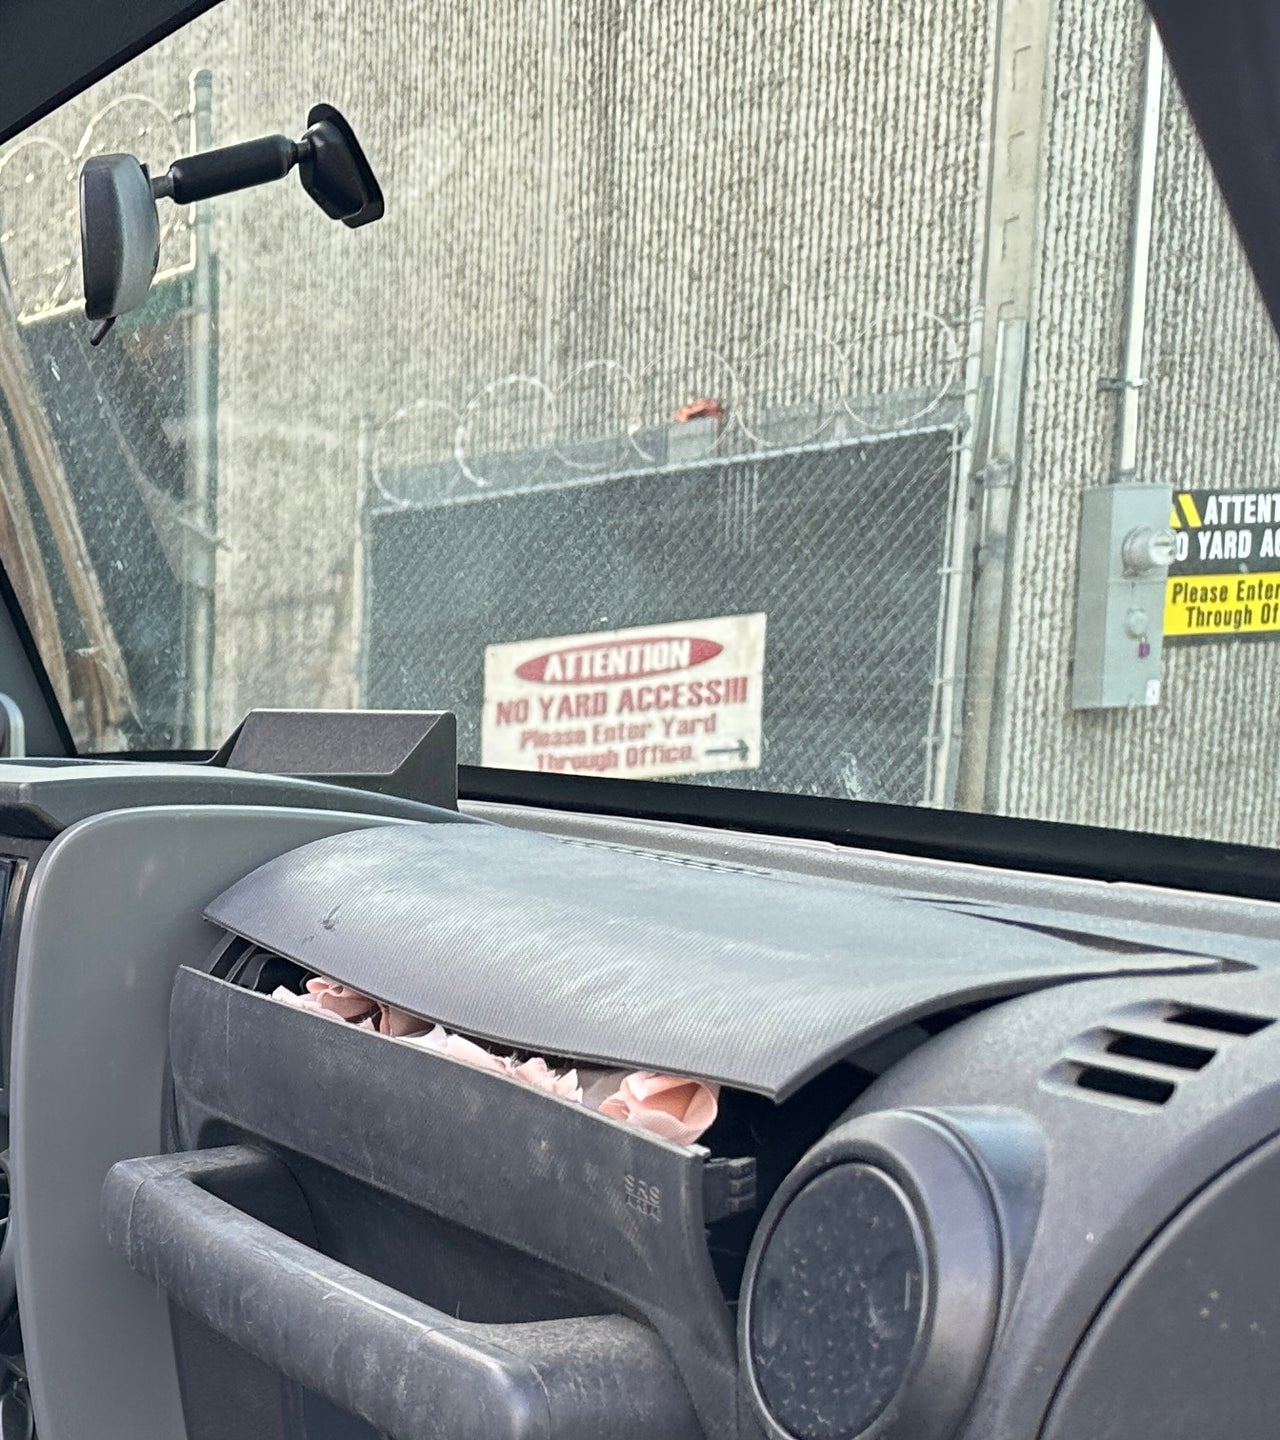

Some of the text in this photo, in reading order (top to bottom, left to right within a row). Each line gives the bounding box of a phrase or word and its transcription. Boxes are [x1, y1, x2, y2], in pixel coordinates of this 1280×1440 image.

[1198, 529, 1252, 560] YARD
[1172, 579, 1280, 604] Please Enter
[1186, 603, 1252, 630] Through
[543, 639, 692, 683] ATTENTION
[496, 700, 530, 727] NO
[539, 692, 608, 722] YARD
[520, 712, 717, 749] Please Enter Yard
[537, 749, 619, 772] Through
